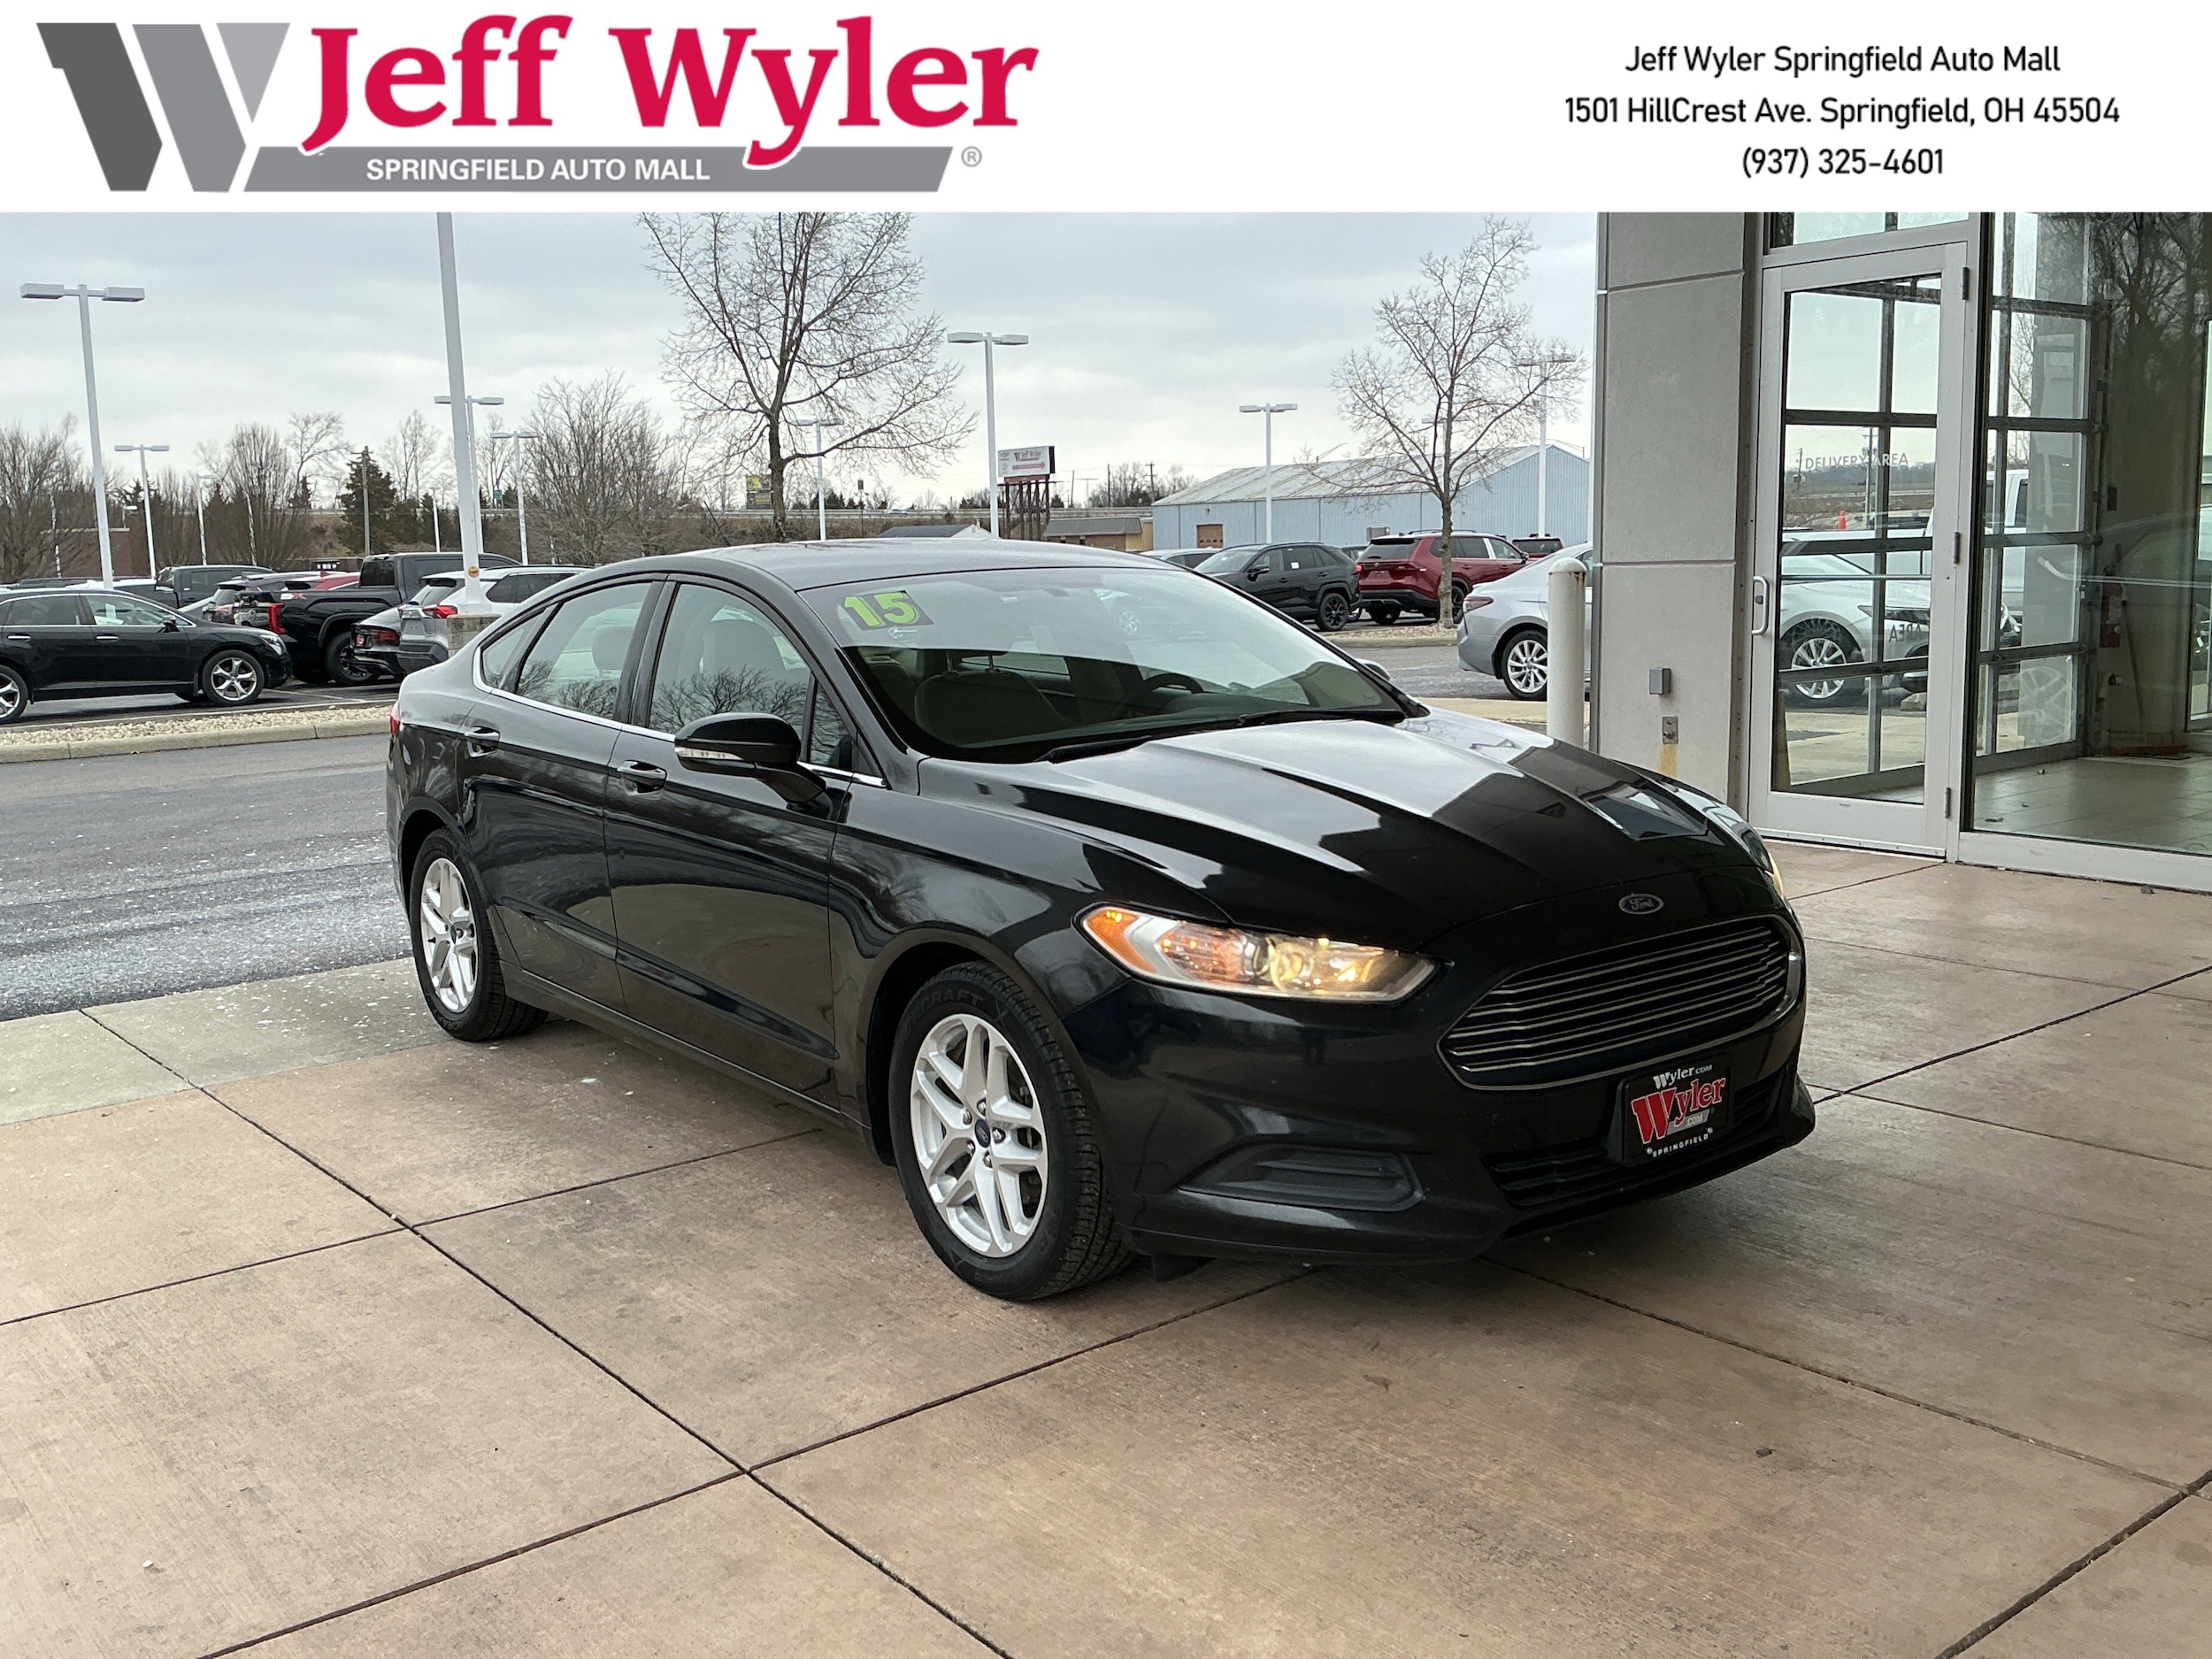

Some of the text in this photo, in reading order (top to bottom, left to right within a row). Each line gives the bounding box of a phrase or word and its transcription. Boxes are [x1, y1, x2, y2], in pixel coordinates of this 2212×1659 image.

[1871, 452, 1909, 466] AREA
[844, 591, 920, 627] 15
[1631, 1078, 1726, 1144] Wyler
[1652, 1133, 1709, 1157] SPRINGFIELD
